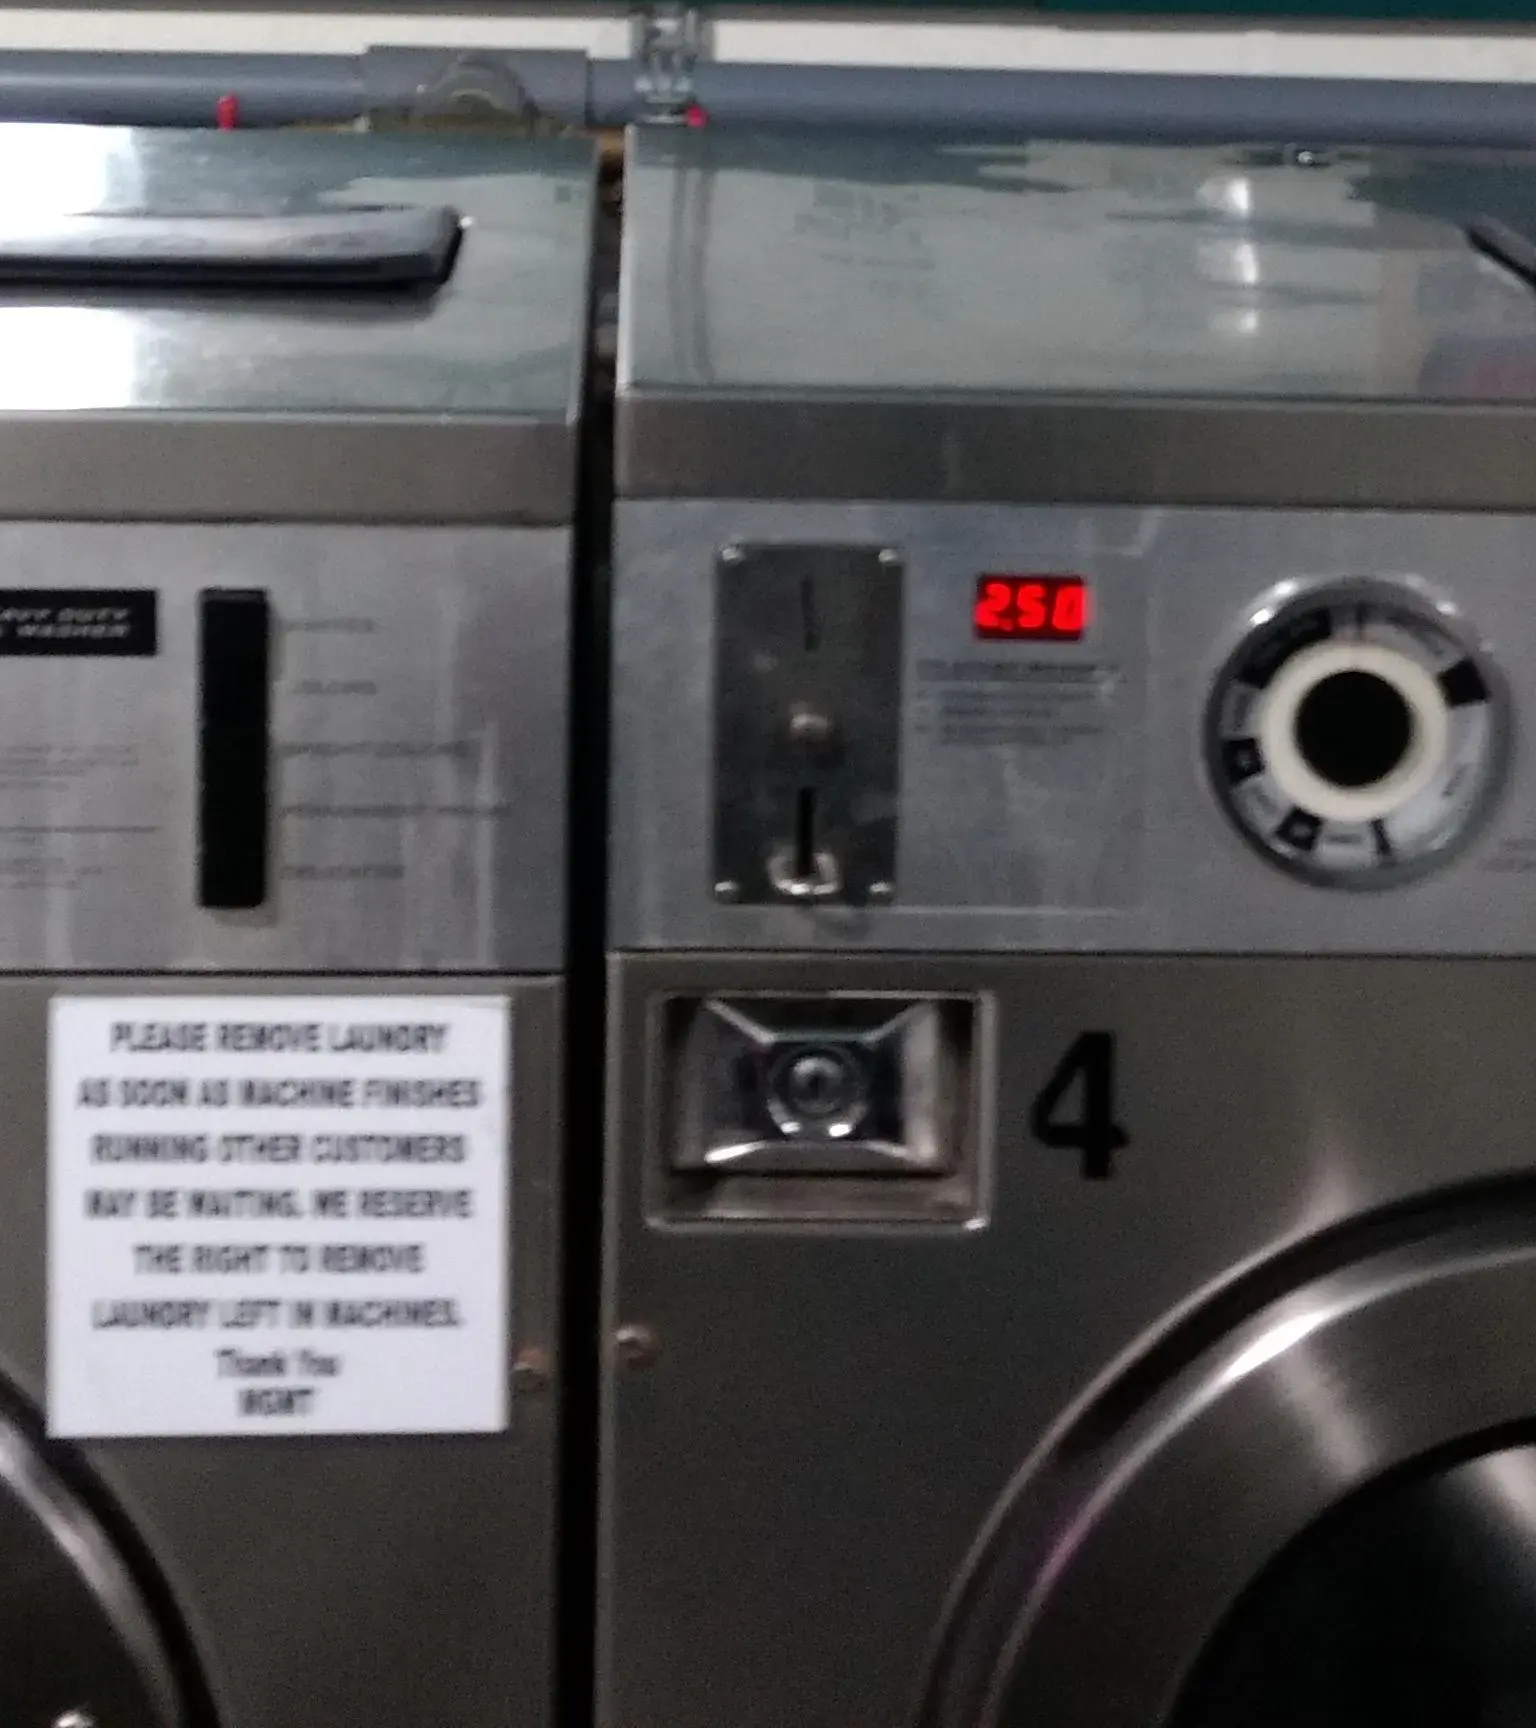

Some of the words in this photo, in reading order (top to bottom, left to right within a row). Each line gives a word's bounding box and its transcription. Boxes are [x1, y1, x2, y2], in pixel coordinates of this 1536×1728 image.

[111, 1022, 208, 1053] PLEASE
[215, 1022, 323, 1053] REMOVE
[328, 1022, 450, 1054] LAUNDRY
[77, 1078, 112, 1108] AS
[117, 1078, 190, 1108] SOON
[197, 1079, 231, 1108] AS
[238, 1078, 356, 1109] MACHINE
[362, 1078, 483, 1109] FINISHES
[1030, 1030, 1130, 1180] 4
[89, 1133, 209, 1164] RUNNING
[217, 1133, 304, 1164] OTHER
[311, 1133, 466, 1164] CUSTOMERS
[85, 1189, 138, 1219] MAY
[146, 1188, 179, 1219] BE
[311, 1189, 350, 1219] WE
[357, 1188, 473, 1219] RESERVE
[133, 1243, 184, 1275] THE
[191, 1243, 269, 1275] RIGHT
[279, 1243, 309, 1275] TO
[320, 1243, 426, 1275] REMOVE
[92, 1298, 210, 1330] LAUNDRY
[218, 1298, 283, 1330] LEFT
[289, 1298, 313, 1330] IN
